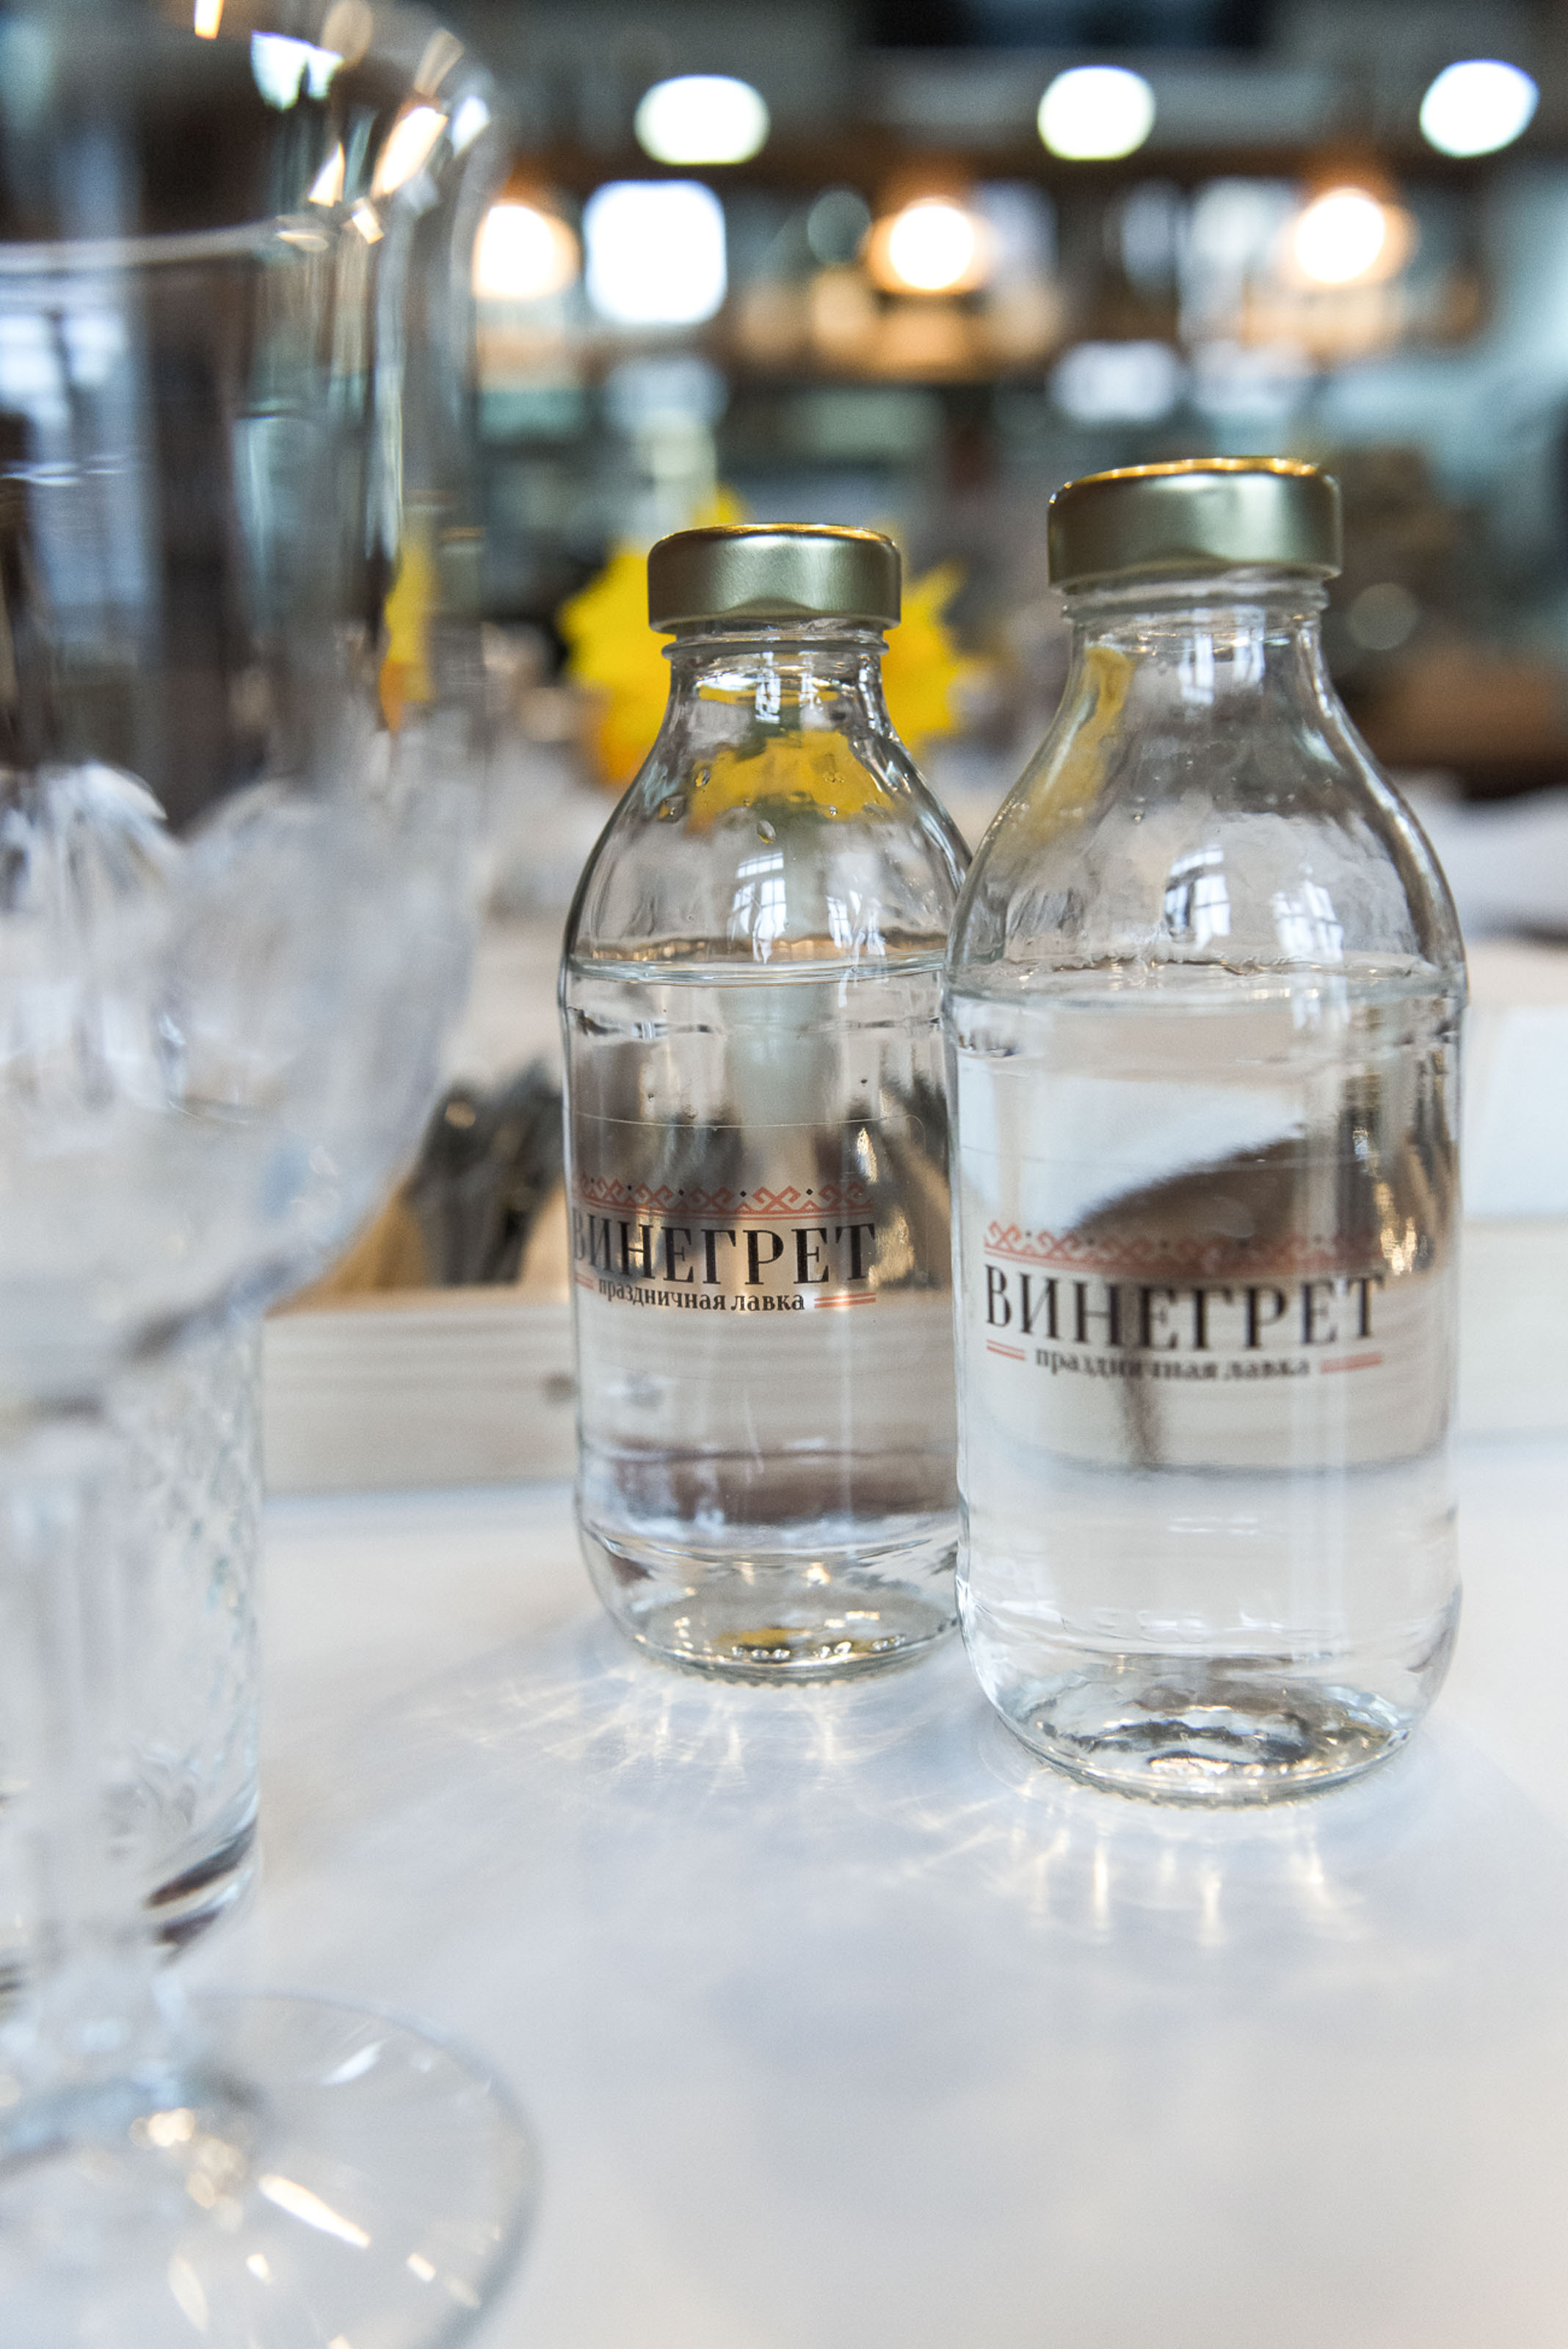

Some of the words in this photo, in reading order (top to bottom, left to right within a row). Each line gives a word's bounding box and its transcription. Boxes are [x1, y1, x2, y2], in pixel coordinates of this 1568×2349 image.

[573, 1208, 876, 1285] ВИНЕГРЕТ
[598, 1279, 725, 1310] праздничная
[731, 1293, 805, 1311] лавка
[984, 1263, 1386, 1350] ВИНЕГРЕТ
